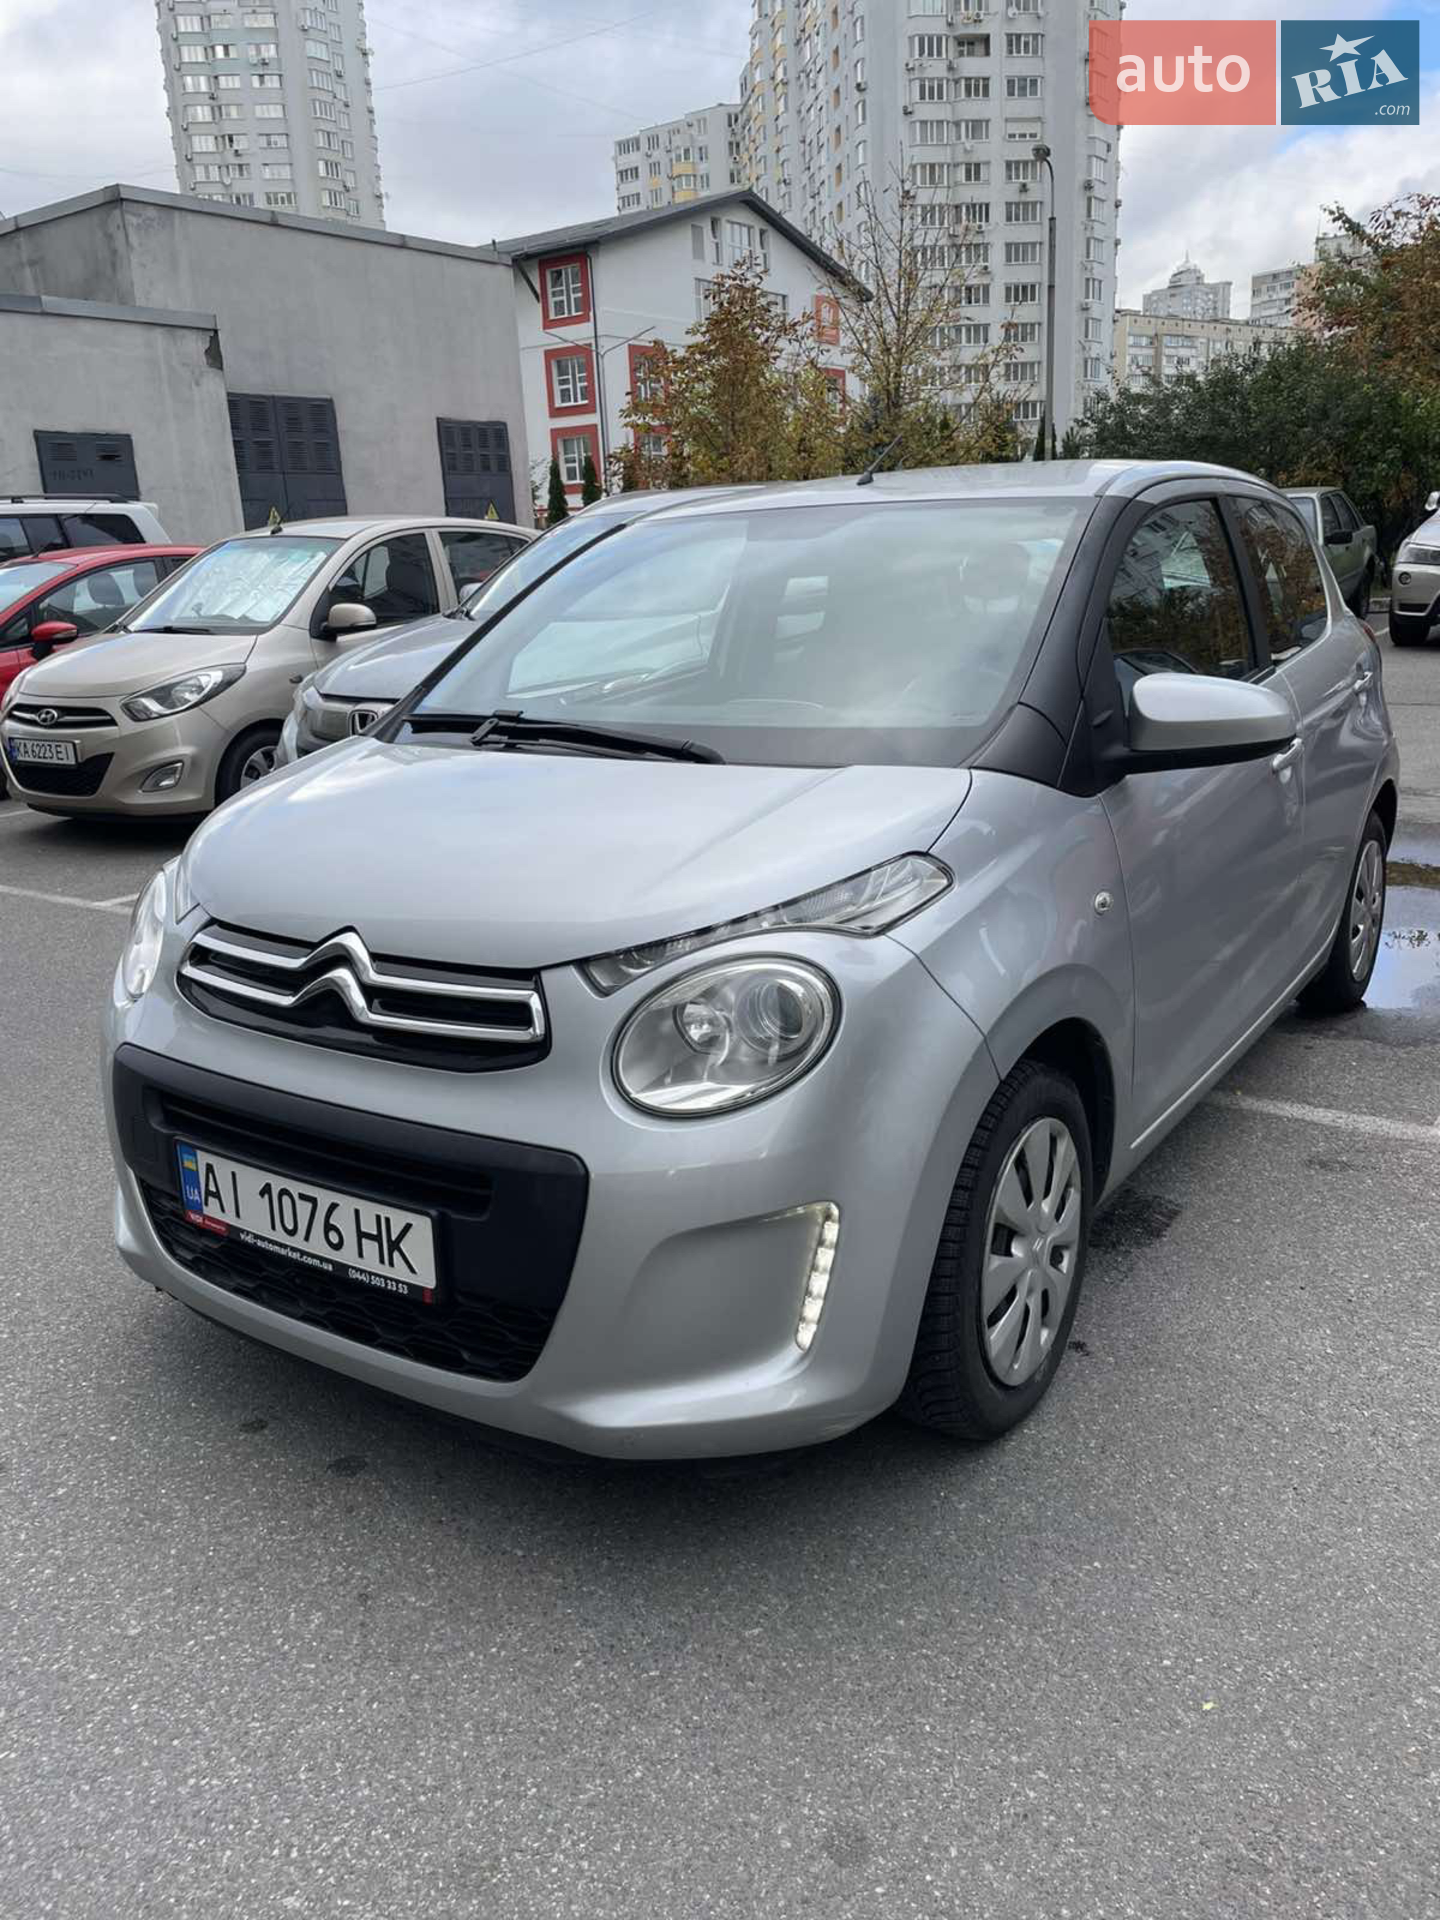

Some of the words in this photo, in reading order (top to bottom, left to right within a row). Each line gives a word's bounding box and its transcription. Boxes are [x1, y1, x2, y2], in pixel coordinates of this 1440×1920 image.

[17, 742, 32, 759] KA
[31, 743, 54, 760] 6223
[55, 744, 69, 761] EI
[185, 1185, 201, 1203] UA
[203, 1162, 241, 1219] AI
[258, 1182, 344, 1251] 1076
[354, 1208, 418, 1275] HK
[239, 1231, 333, 1271] vidi-automarket.com.ua
[348, 1268, 370, 1284] (044)
[370, 1275, 386, 1288] 503
[386, 1279, 397, 1292] 33
[397, 1282, 409, 1294] 53
